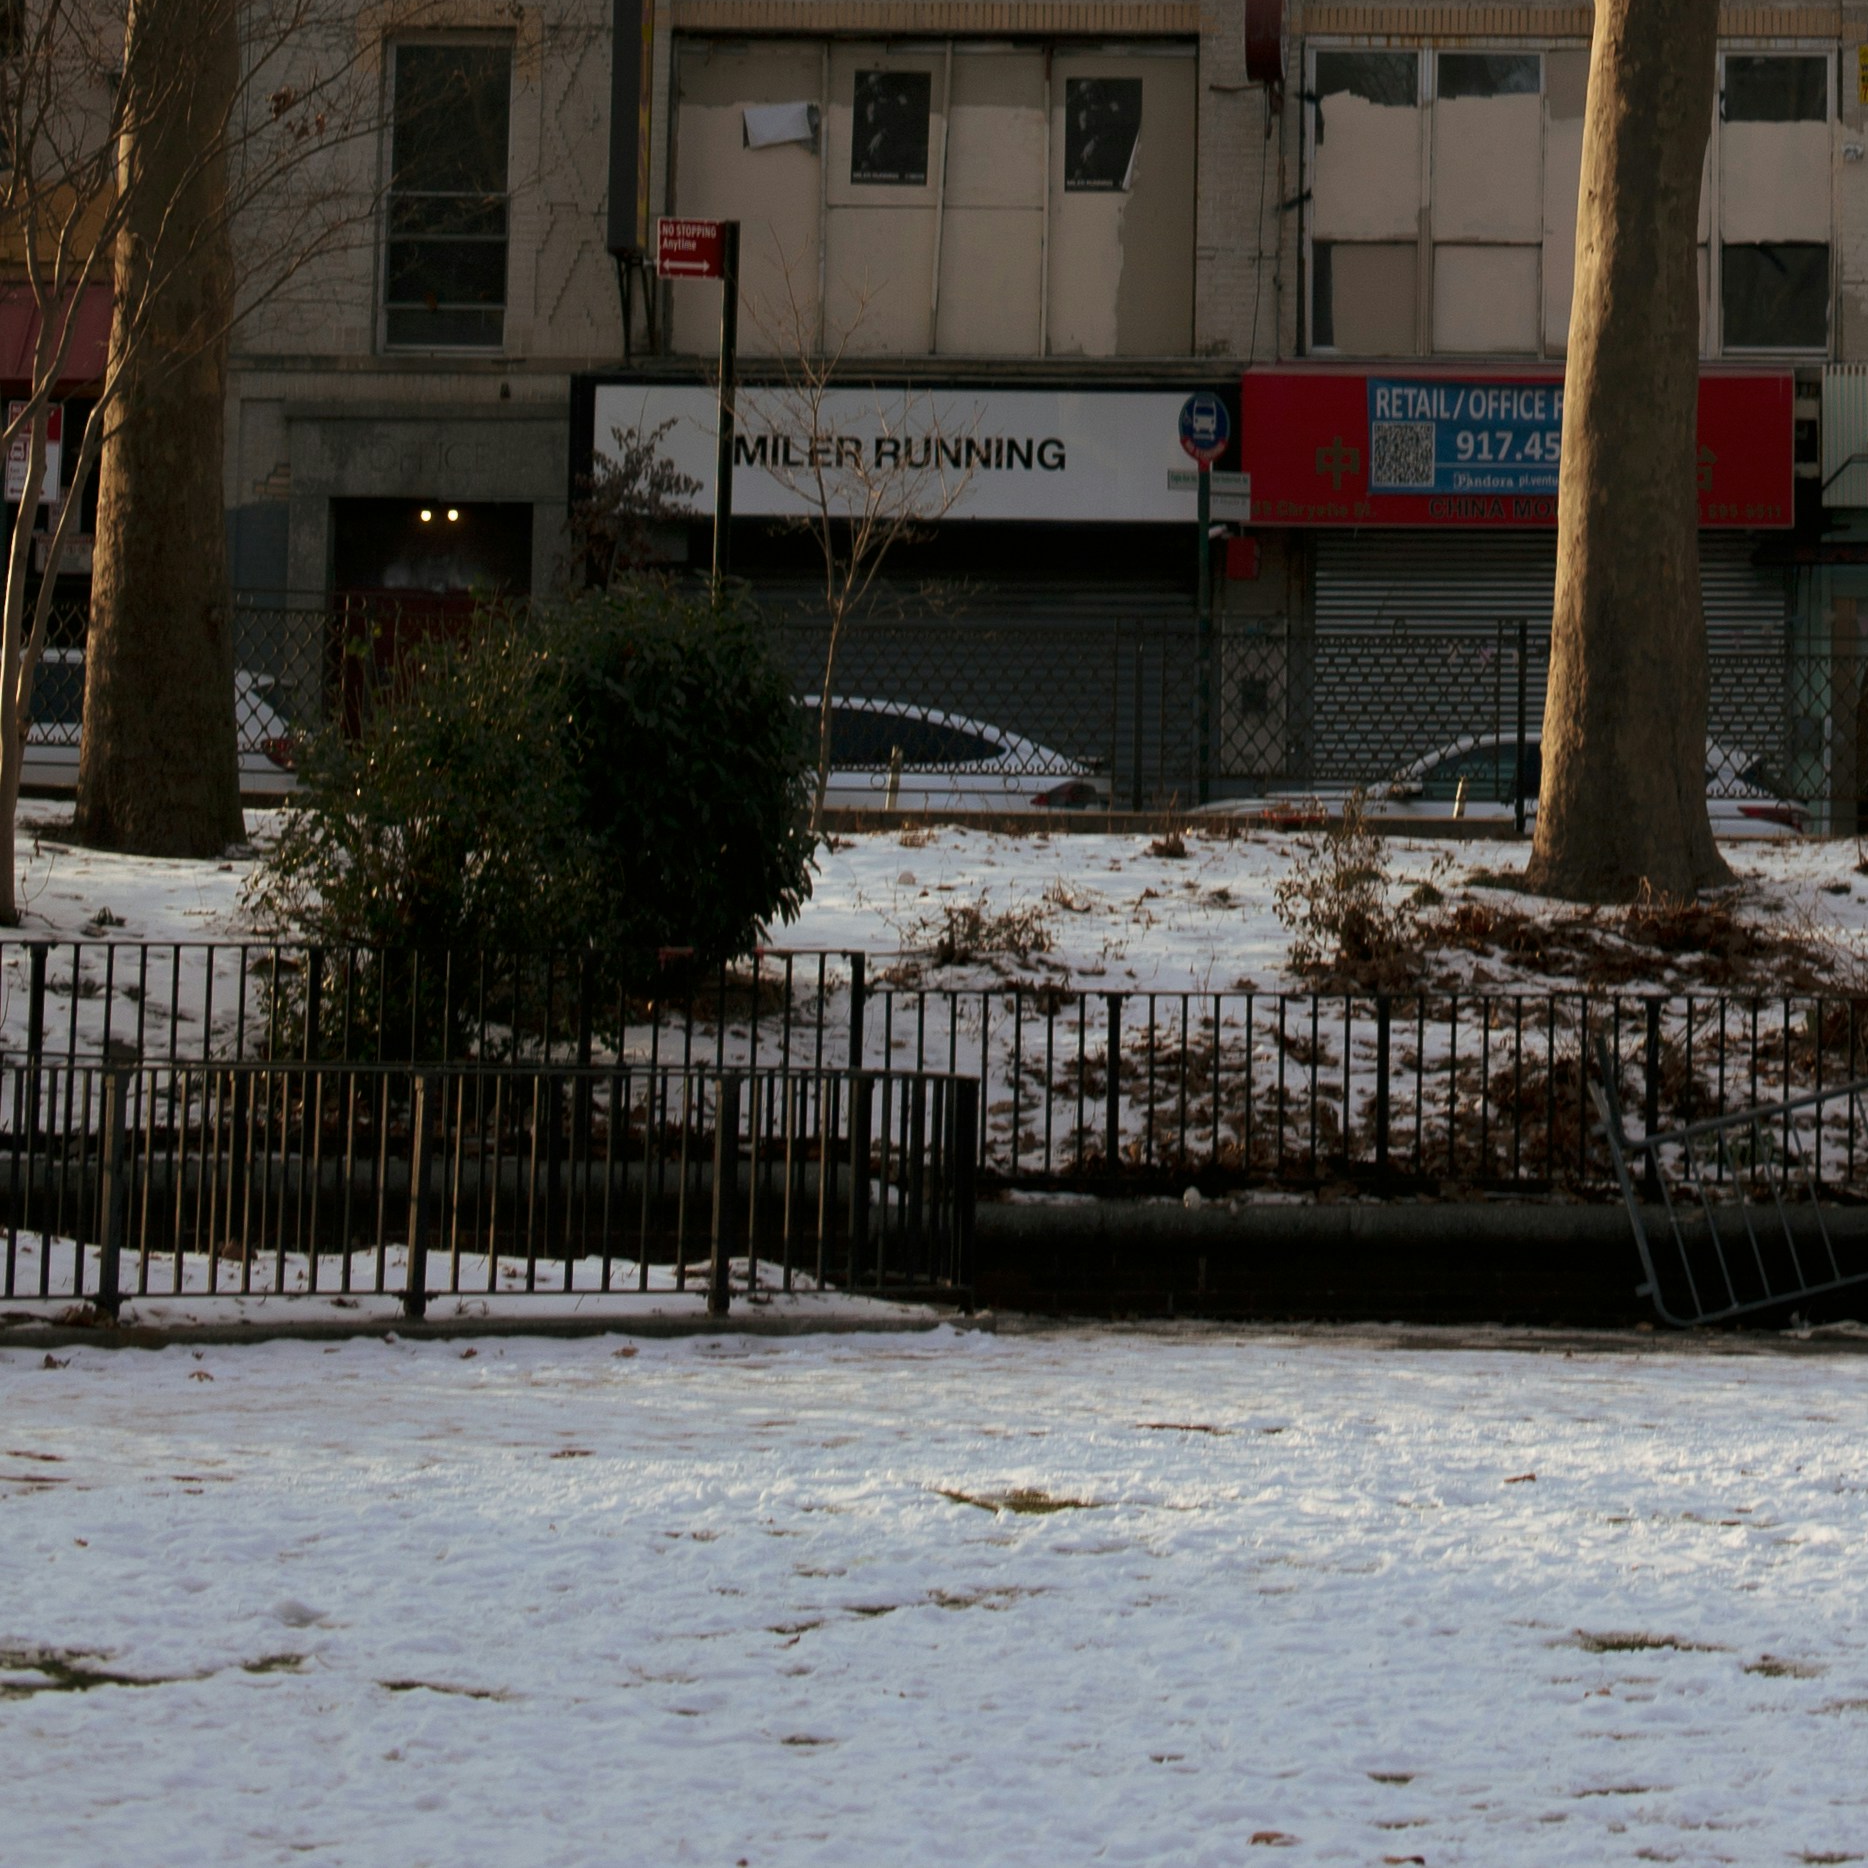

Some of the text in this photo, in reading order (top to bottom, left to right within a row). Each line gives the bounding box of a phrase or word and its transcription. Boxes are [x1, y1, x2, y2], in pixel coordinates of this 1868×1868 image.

[662, 223, 717, 239] NO STOPPING
[662, 237, 697, 252] Anytime
[733, 434, 1067, 472] MILER RUNNING
[1456, 430, 1561, 461] 917.45
[1314, 435, 1361, 491] 中
[1453, 471, 1514, 489] Pandora
[1428, 495, 1559, 519] CHINA MO
